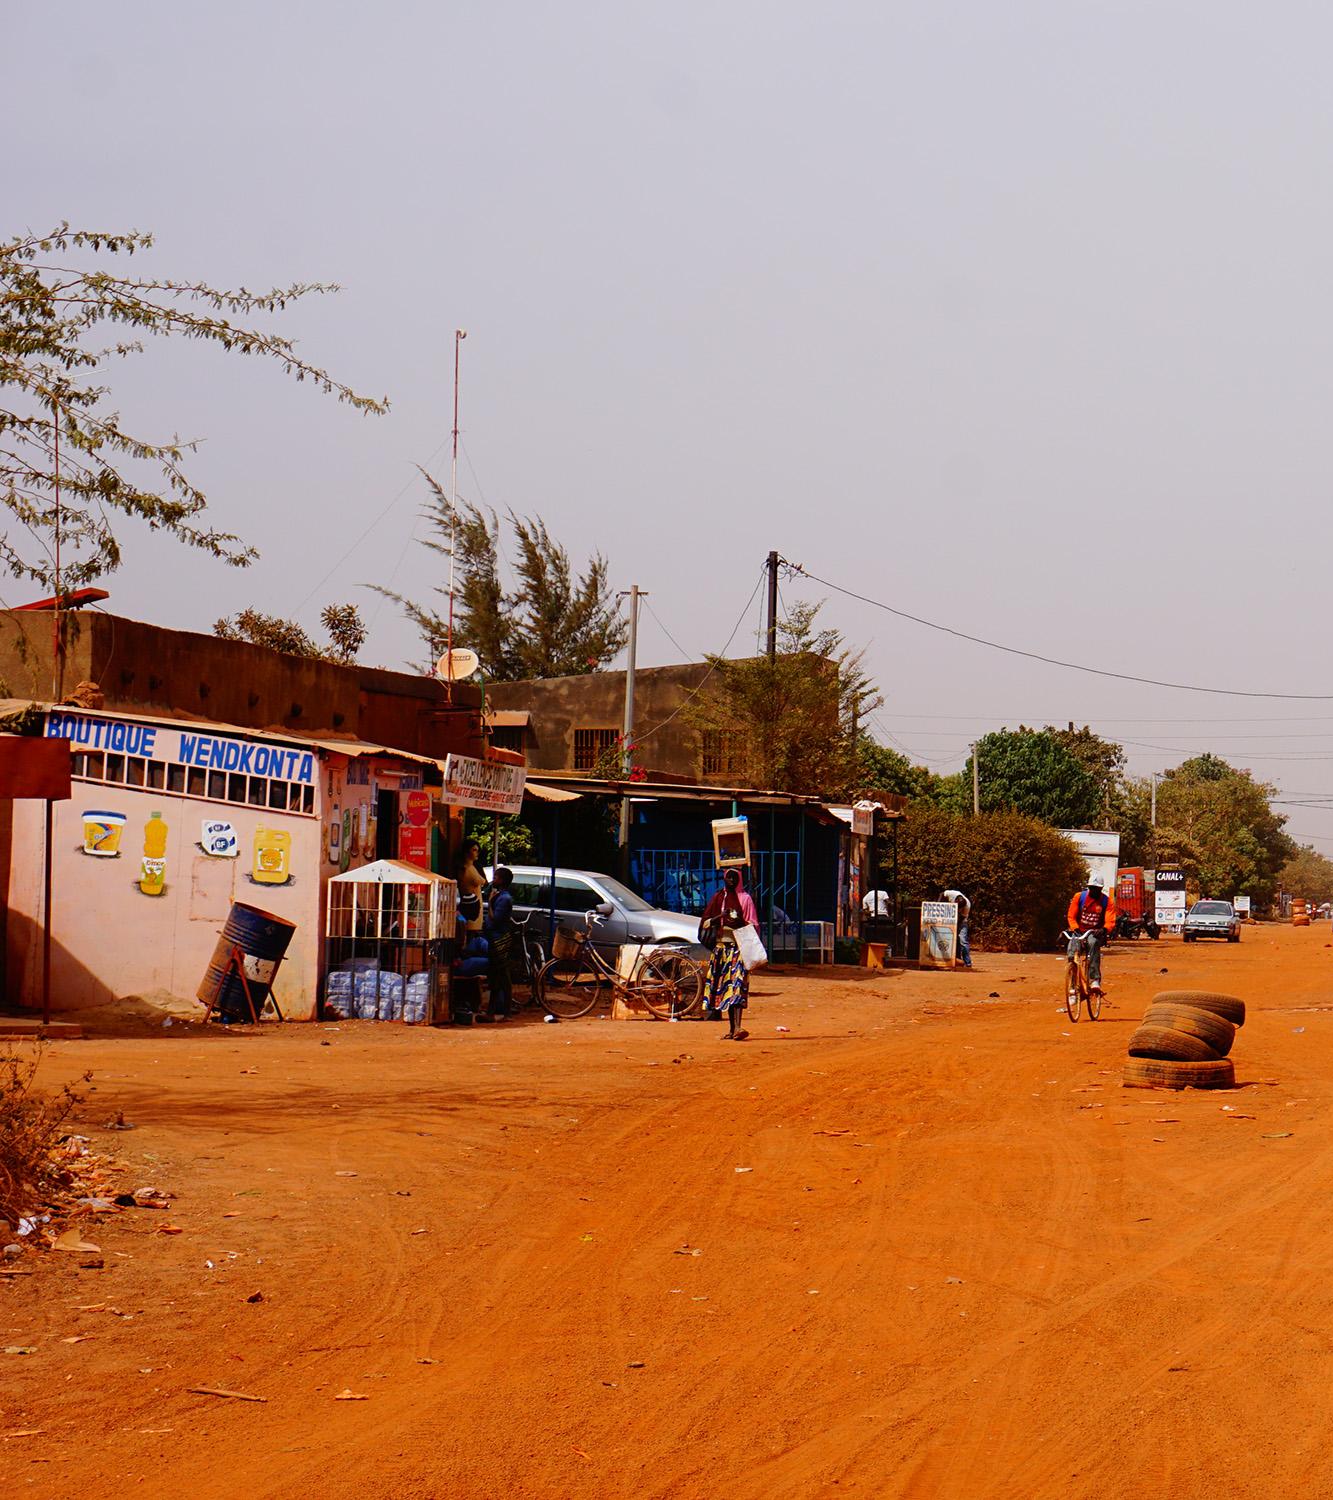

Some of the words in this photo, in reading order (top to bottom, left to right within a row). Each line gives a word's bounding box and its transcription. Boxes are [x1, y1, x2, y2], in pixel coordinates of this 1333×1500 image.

[47, 713, 157, 757] BOUTIQUE
[178, 734, 312, 783] WENDKONTA
[1156, 872, 1183, 881] CANAL+
[922, 903, 956, 918] PRESSING
